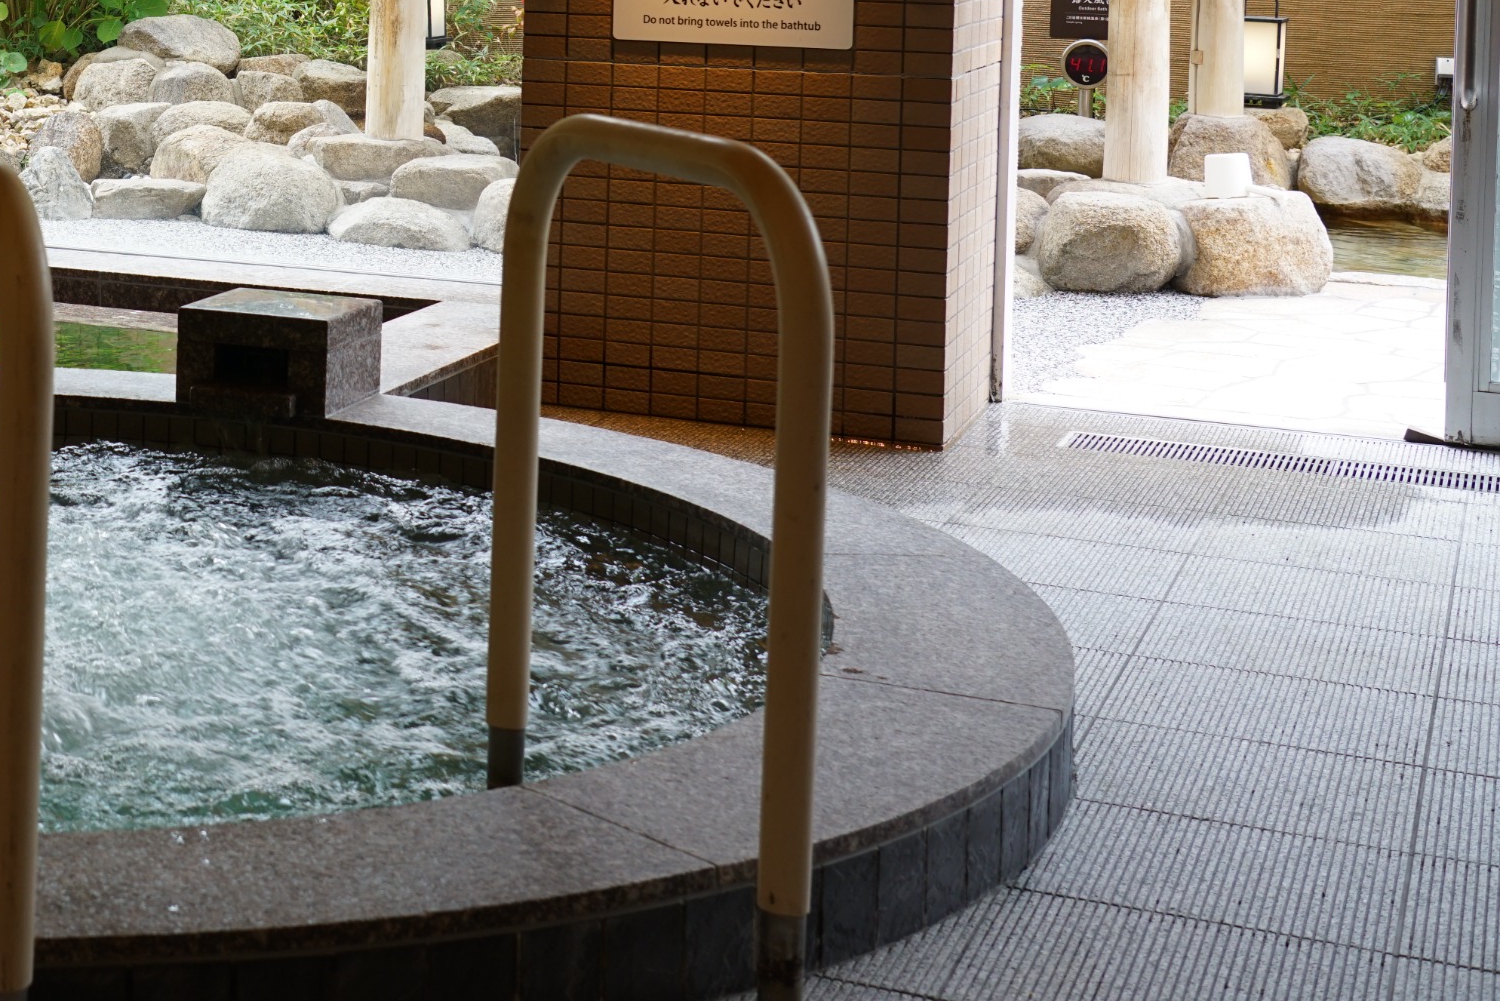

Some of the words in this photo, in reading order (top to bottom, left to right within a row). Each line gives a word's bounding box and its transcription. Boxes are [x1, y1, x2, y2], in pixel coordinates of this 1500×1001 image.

[643, 15, 657, 24] Do
[659, 16, 675, 25] not
[678, 16, 703, 28] bring
[706, 18, 738, 28] towels
[740, 19, 760, 29] into
[762, 20, 778, 30] the
[781, 20, 821, 31] bathtub
